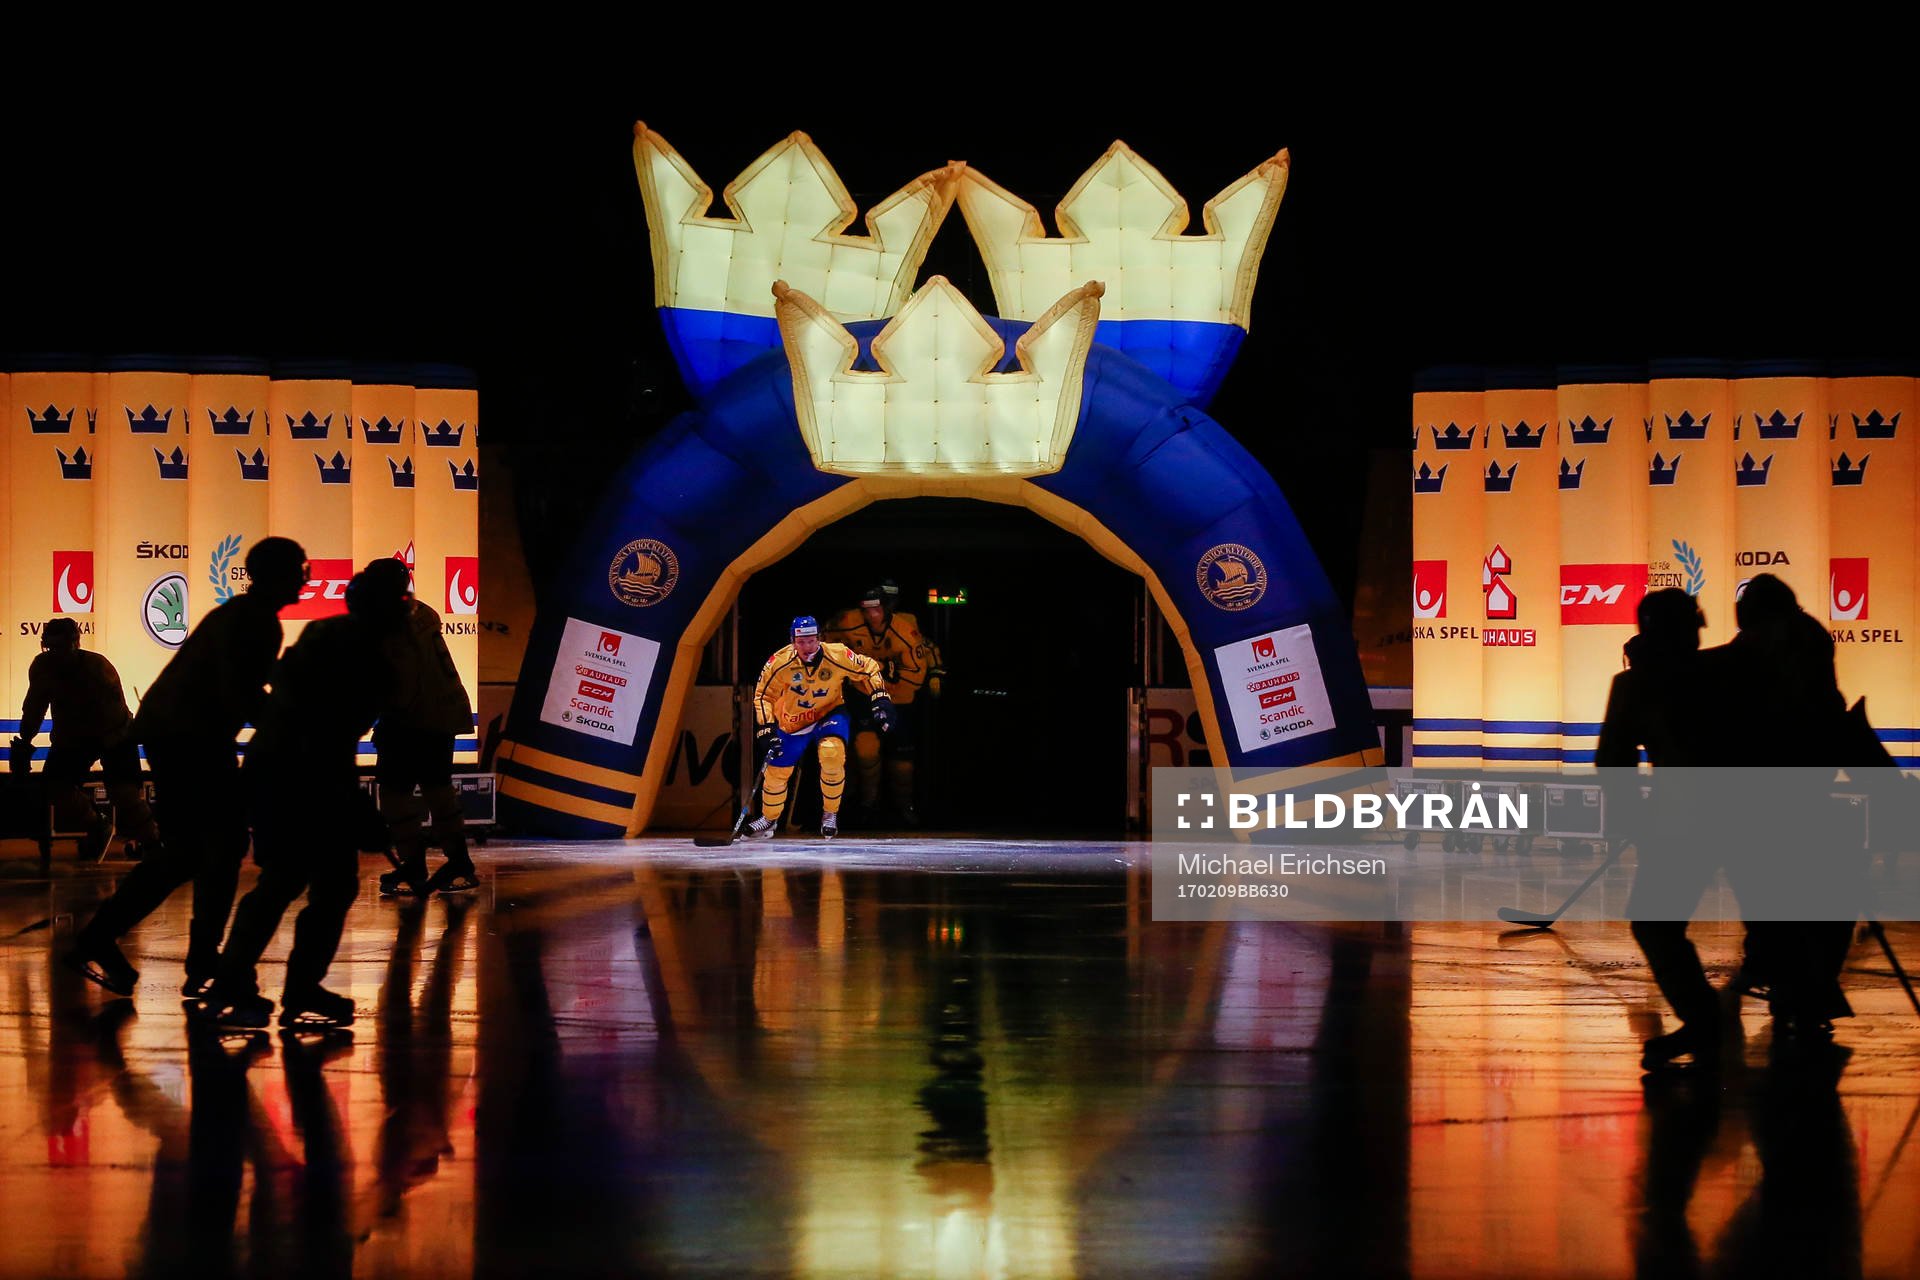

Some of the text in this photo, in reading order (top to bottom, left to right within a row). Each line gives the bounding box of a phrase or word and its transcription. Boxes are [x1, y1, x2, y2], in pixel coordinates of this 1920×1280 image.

[1440, 626, 1479, 640] SPEL
[1861, 630, 1903, 643] SPEL
[585, 650, 627, 667] SVENSKA SPEL
[1247, 657, 1290, 673] SVENSKA SPEL
[582, 667, 627, 687] BAUHAUS
[1255, 672, 1300, 690] BAUHAUS
[581, 685, 613, 698] CCM
[1262, 691, 1293, 704] CCM
[569, 697, 614, 719] Scandic
[1259, 704, 1305, 725] Scandic
[576, 715, 615, 733] ŠKODA
[1273, 719, 1314, 735] ŠKODA
